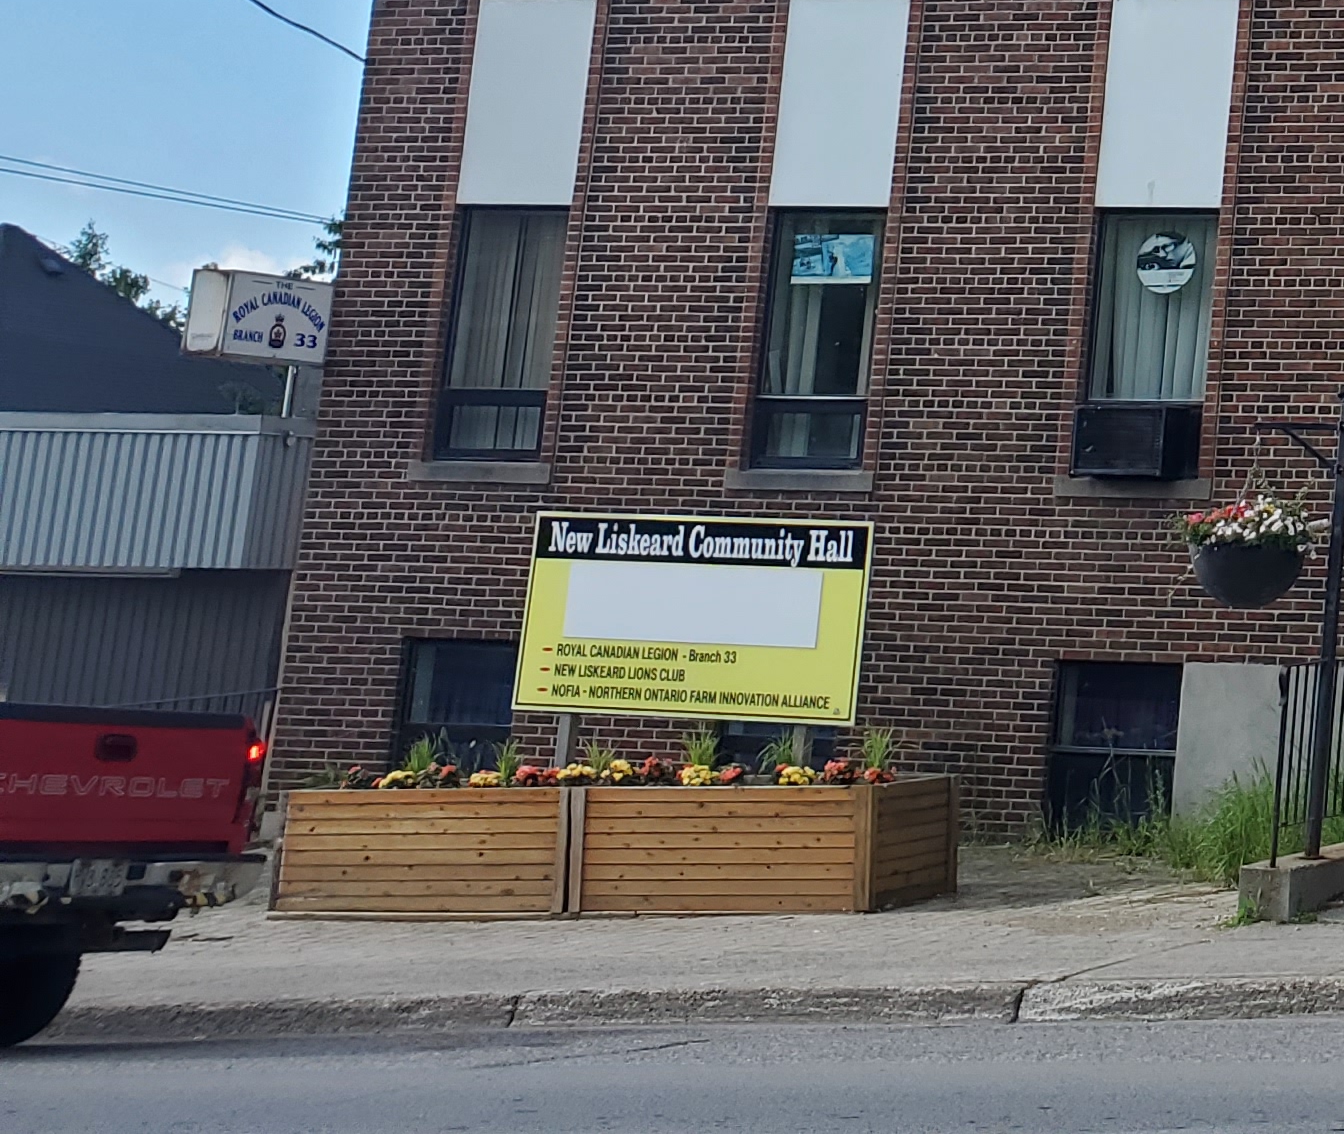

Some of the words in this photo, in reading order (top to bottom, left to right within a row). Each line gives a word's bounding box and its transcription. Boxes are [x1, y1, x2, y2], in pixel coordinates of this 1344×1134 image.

[275, 281, 294, 290] THE
[232, 297, 259, 323] ROYAL
[262, 291, 303, 309] CANADIAN
[301, 301, 325, 332] LEGION
[233, 329, 264, 343] BRANCH
[293, 333, 317, 349] 33
[548, 521, 593, 553] New
[595, 522, 684, 556] Liskeard
[688, 525, 804, 567] Community
[807, 529, 853, 562] Hall
[556, 643, 587, 657] ROYAL
[590, 645, 639, 659] CANADIAN
[641, 647, 678, 661] LEGION
[688, 649, 721, 663] Branch
[723, 651, 737, 663] 33
[554, 664, 576, 677] NEW
[578, 665, 625, 679] LISKEARD
[627, 668, 657, 681] LIONS
[659, 669, 685, 682] CLUB
[551, 684, 580, 698] NOFIA
[588, 686, 641, 700] NORTHERN
[644, 688, 687, 703] ONTARIO
[689, 690, 716, 704] FARM
[719, 692, 779, 707] INNOVATION
[780, 694, 830, 709] ALLIANCE
[0, 772, 229, 798] HEVROLET
